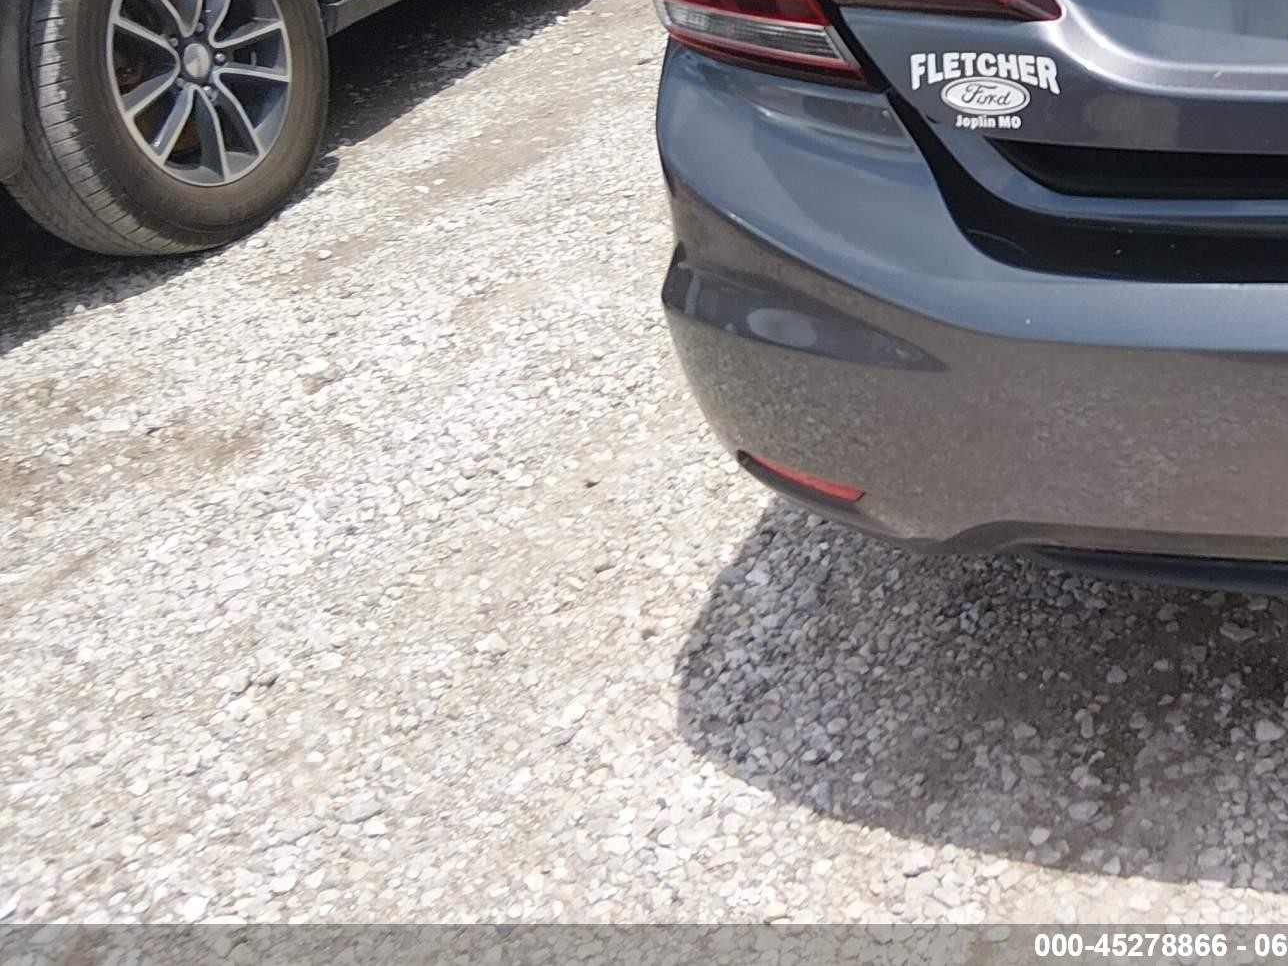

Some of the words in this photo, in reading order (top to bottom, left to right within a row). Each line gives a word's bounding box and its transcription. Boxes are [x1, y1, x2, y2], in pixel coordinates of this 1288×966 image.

[910, 52, 1060, 95] FLETCHER
[961, 82, 1012, 106] Ford
[955, 114, 996, 130] Joplin
[998, 115, 1022, 129] MO
